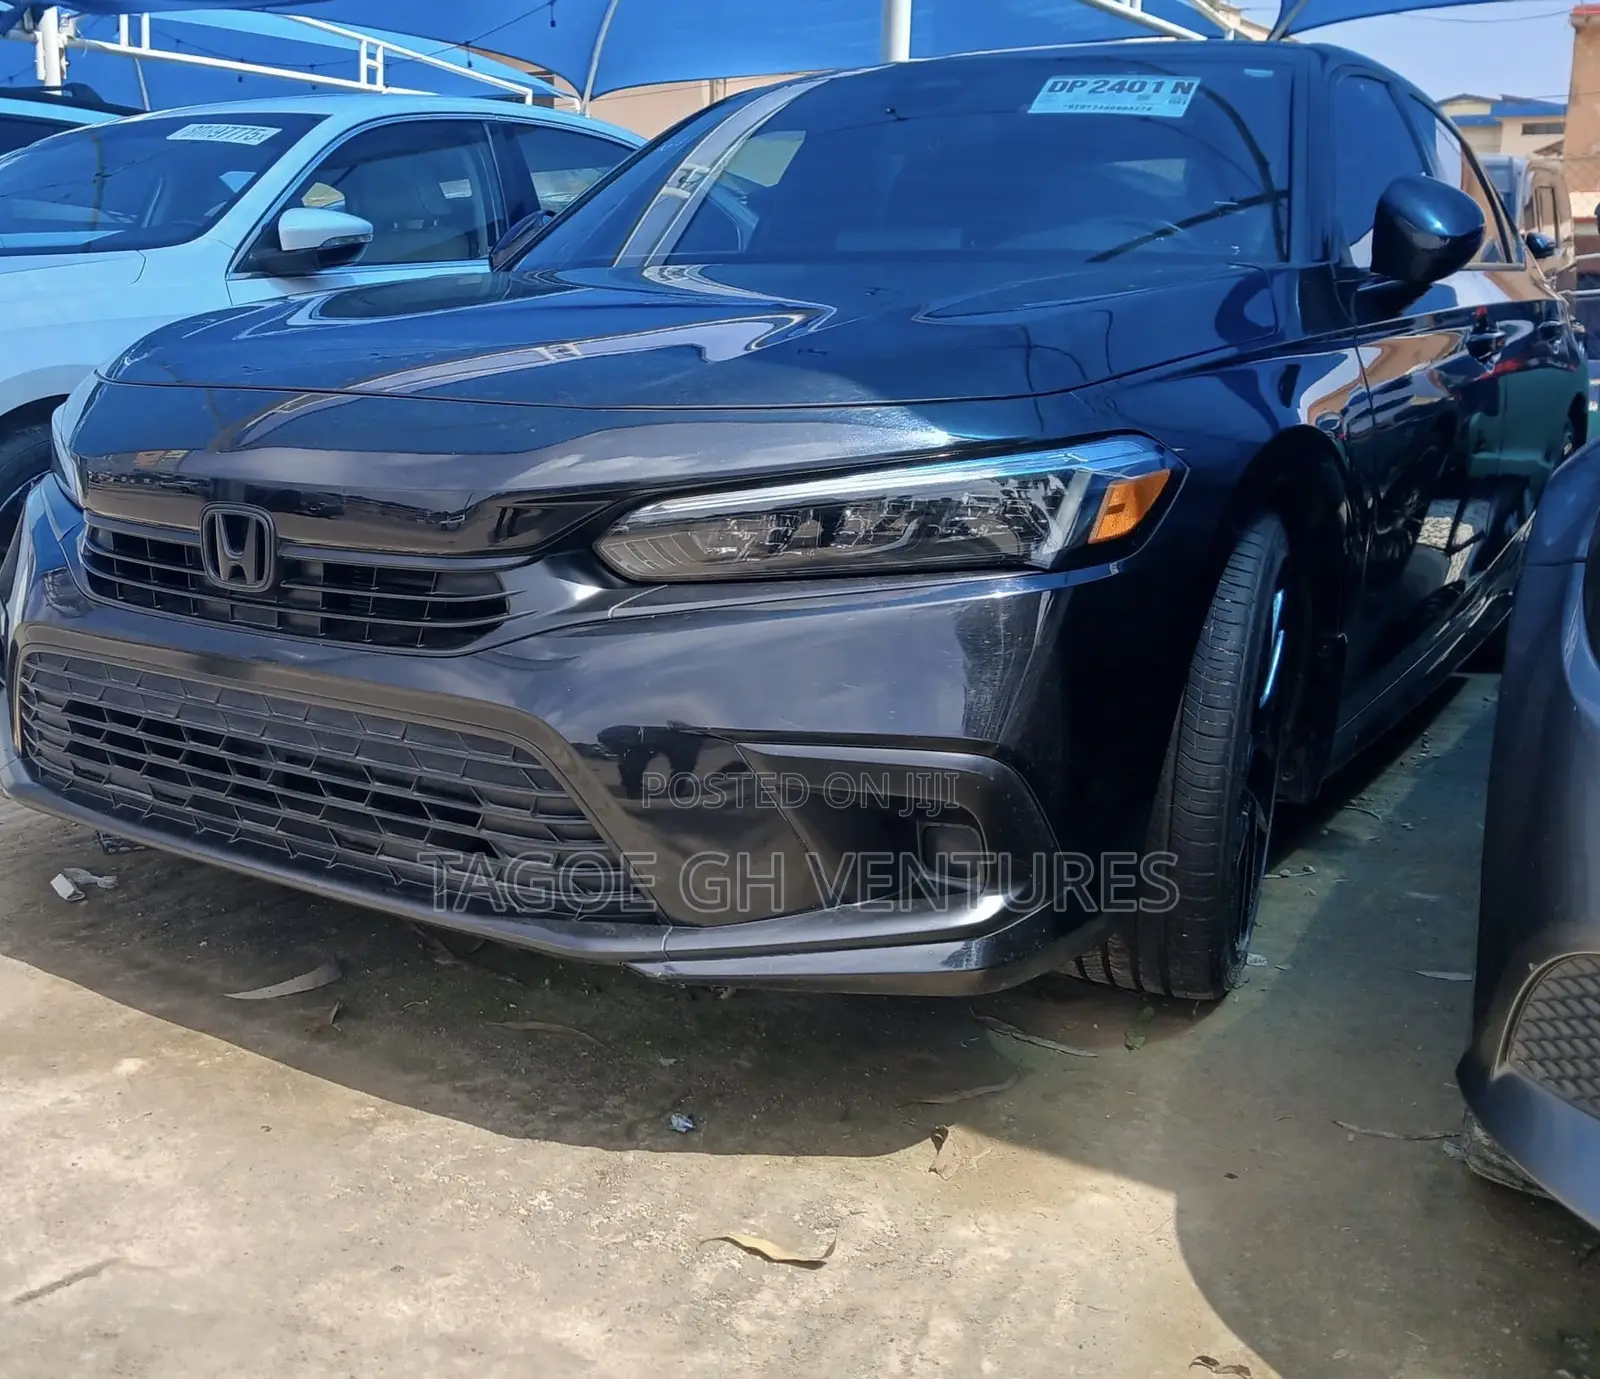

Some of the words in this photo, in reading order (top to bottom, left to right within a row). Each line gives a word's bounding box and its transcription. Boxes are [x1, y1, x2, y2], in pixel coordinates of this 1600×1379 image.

[1047, 80, 1088, 93] DP
[1088, 79, 1165, 94] 2401
[1170, 81, 1195, 94] N
